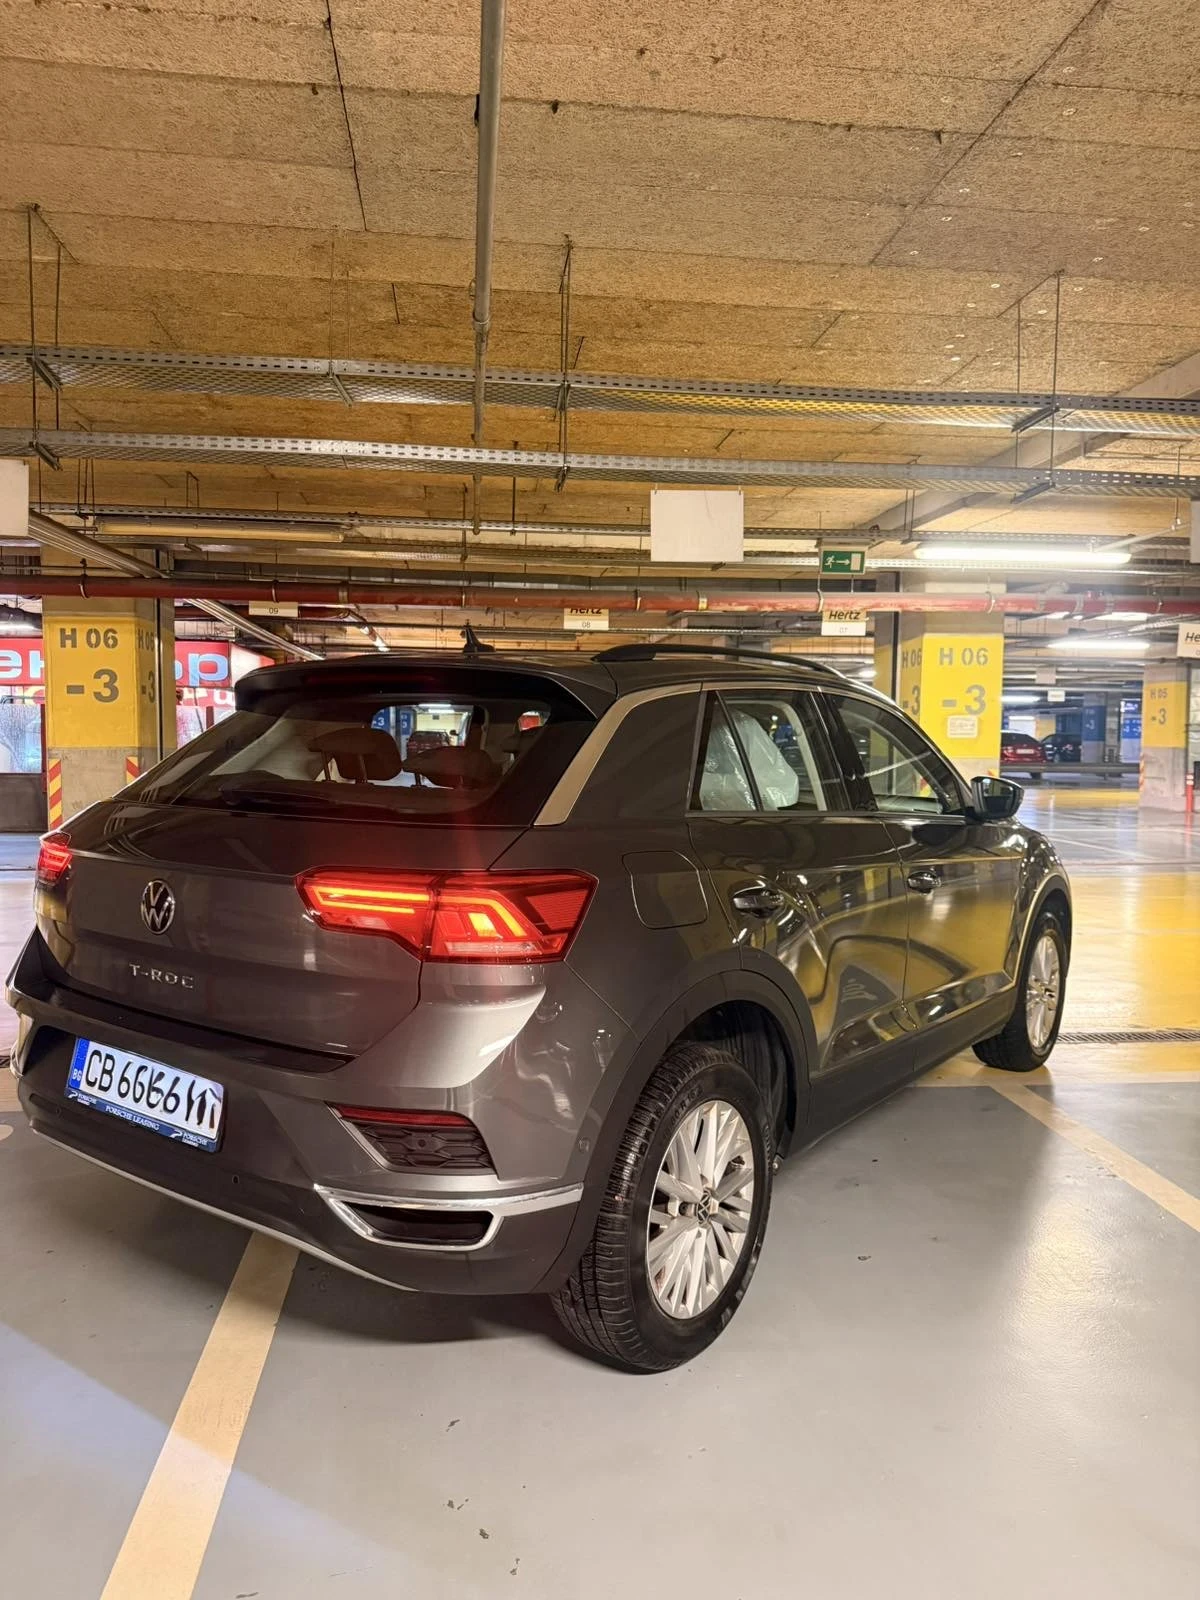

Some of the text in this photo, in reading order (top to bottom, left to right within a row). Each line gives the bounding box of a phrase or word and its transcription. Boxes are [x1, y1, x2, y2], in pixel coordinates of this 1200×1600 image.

[829, 609, 861, 620] Hertz
[59, 627, 119, 649] H 06
[939, 647, 989, 666] H 06
[129, 963, 194, 989] T-ROC
